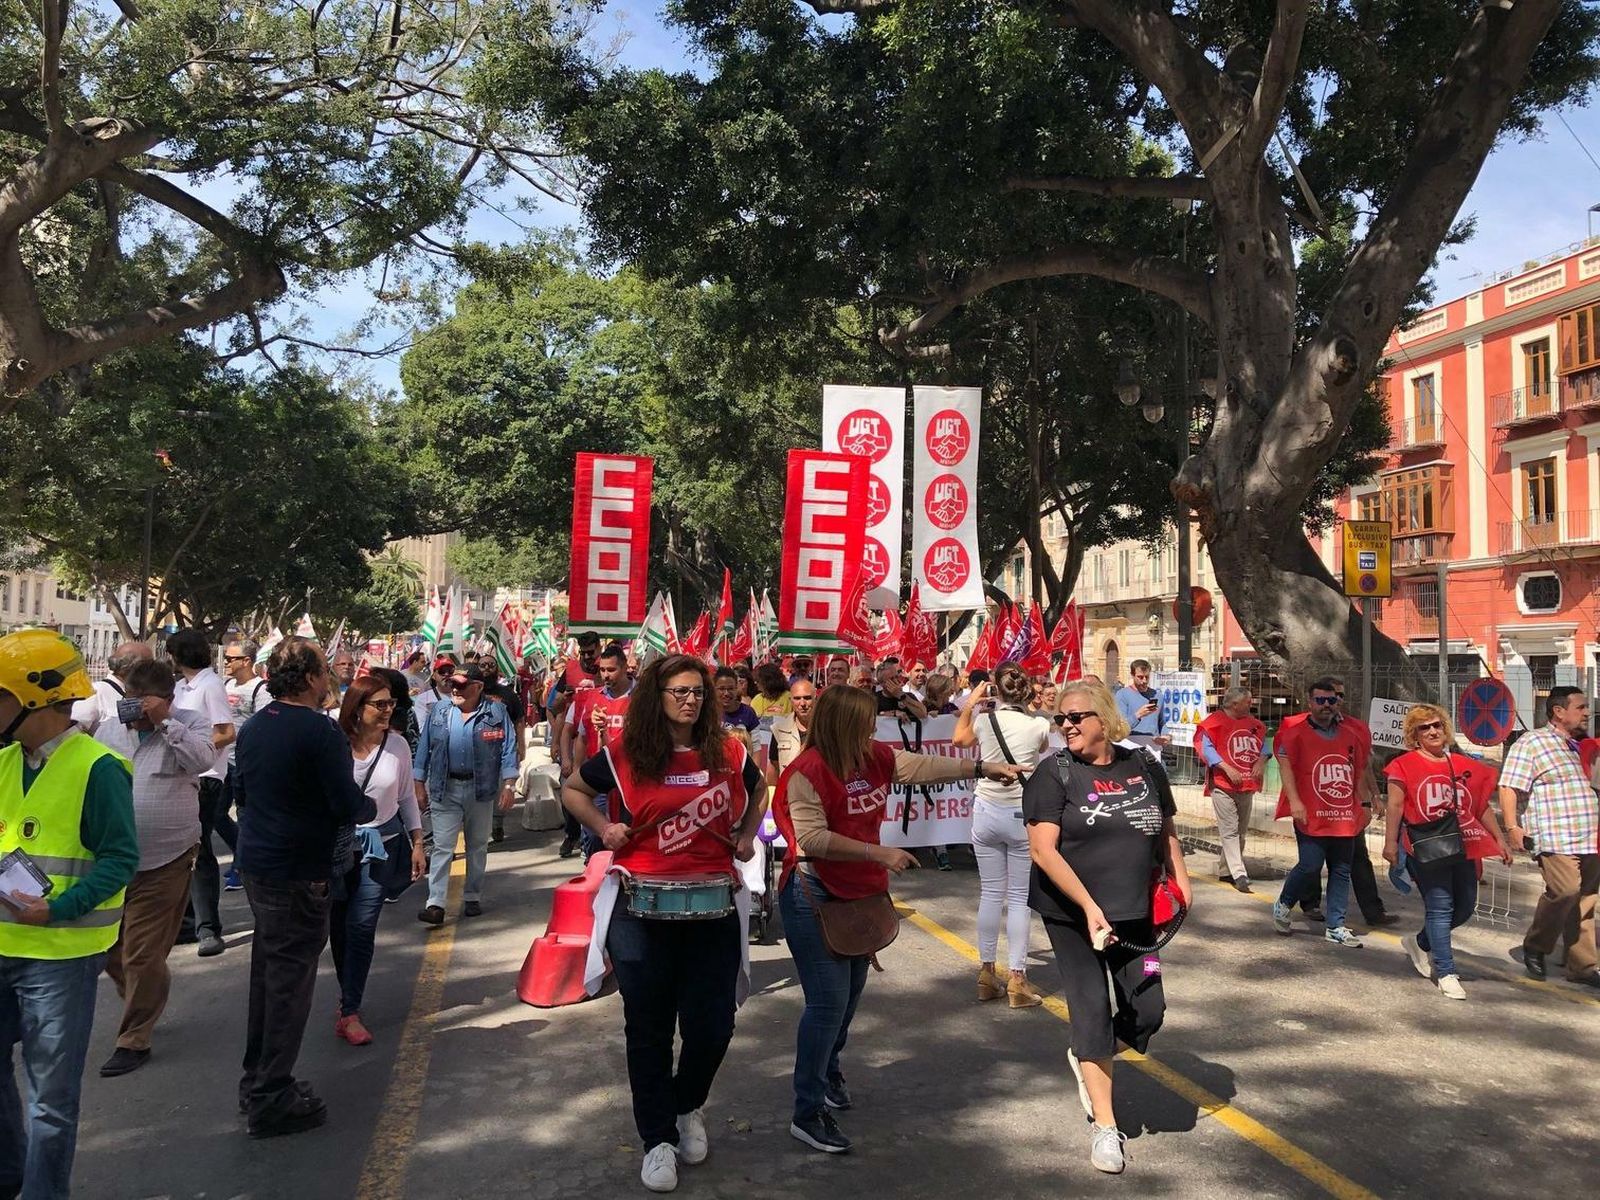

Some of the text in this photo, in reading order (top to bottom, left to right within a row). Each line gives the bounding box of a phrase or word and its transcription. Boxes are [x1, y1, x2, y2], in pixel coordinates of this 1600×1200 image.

[849, 417, 881, 438] UGT
[935, 418, 961, 438] UGT
[934, 482, 960, 502] UGT
[586, 458, 636, 622] CCOO
[794, 459, 850, 631] CCOO
[1348, 541, 1388, 549] BUS TAXI
[933, 545, 959, 565] UGT
[1382, 703, 1408, 716] SALID
[1233, 736, 1260, 753] UGT
[1319, 764, 1352, 785] UGT
[1093, 779, 1125, 793] NO
[1426, 782, 1465, 807] UGT
[883, 800, 919, 822] LAS
[924, 797, 970, 820] PERS
